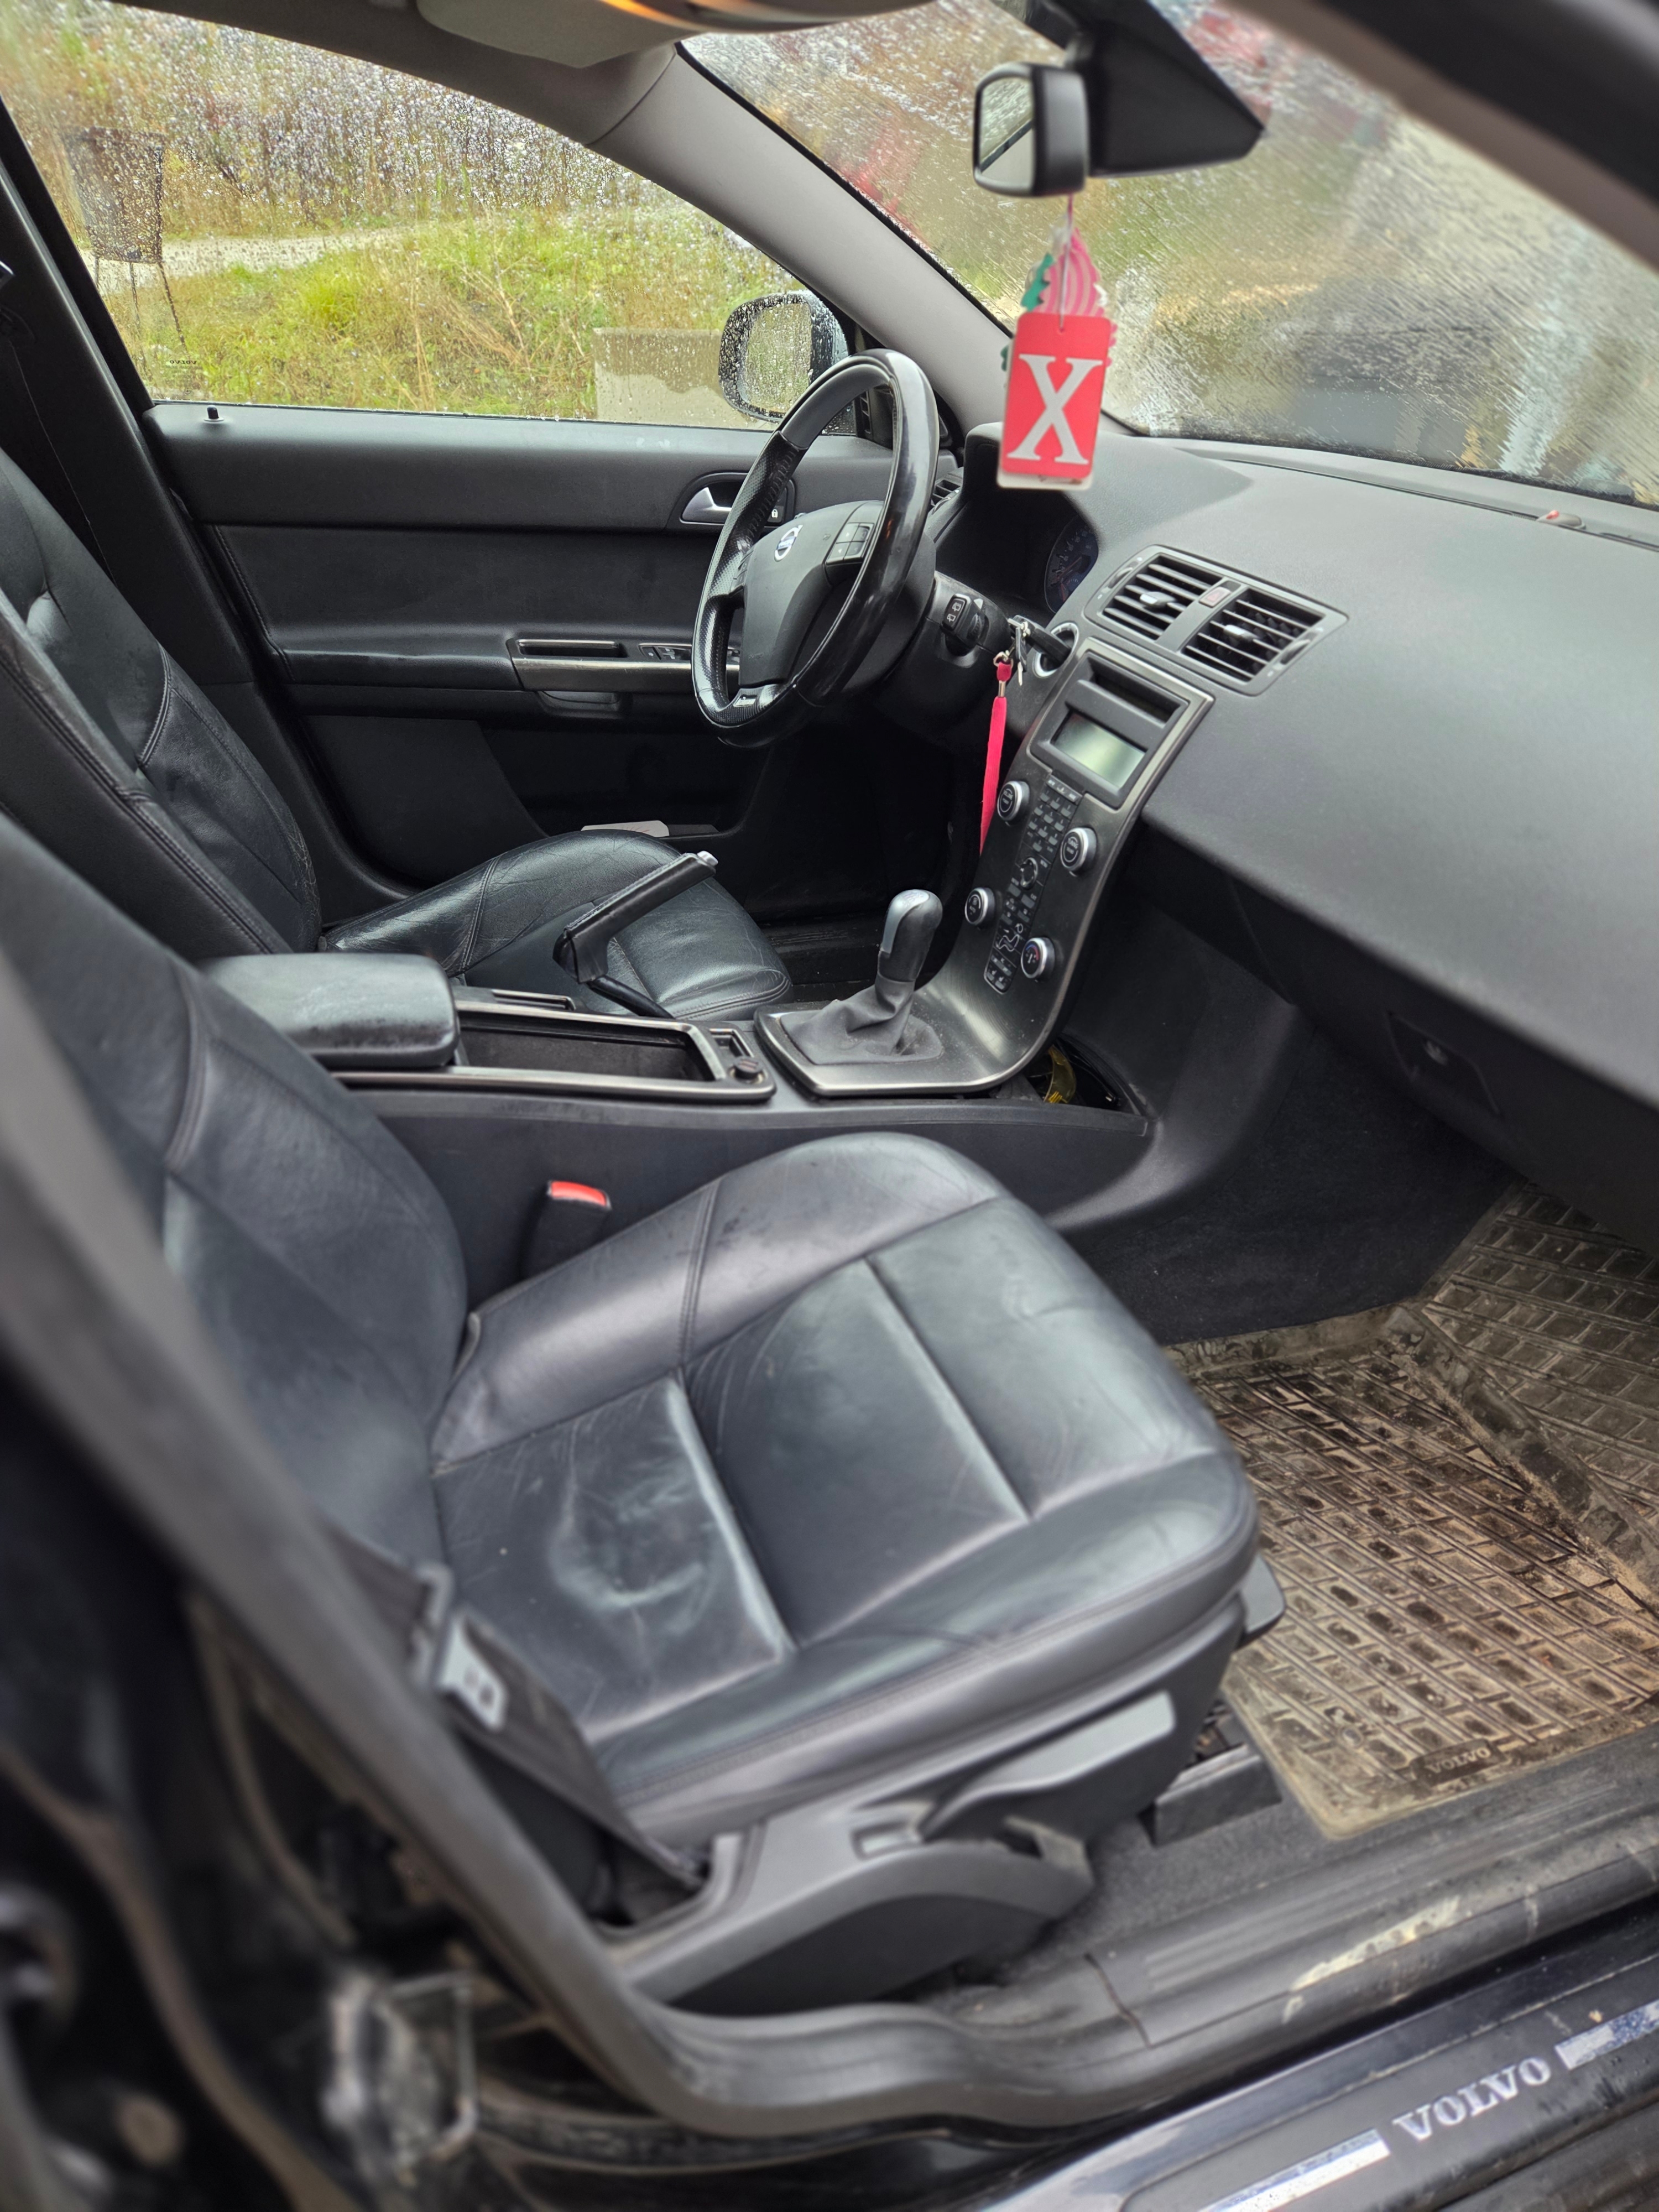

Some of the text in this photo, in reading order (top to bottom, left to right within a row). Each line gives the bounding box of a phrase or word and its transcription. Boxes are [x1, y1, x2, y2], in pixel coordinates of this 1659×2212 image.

[1006, 353, 1104, 465] X
[1424, 1747, 1492, 1773] VOLVO
[1391, 2057, 1551, 2141] VOLVO
